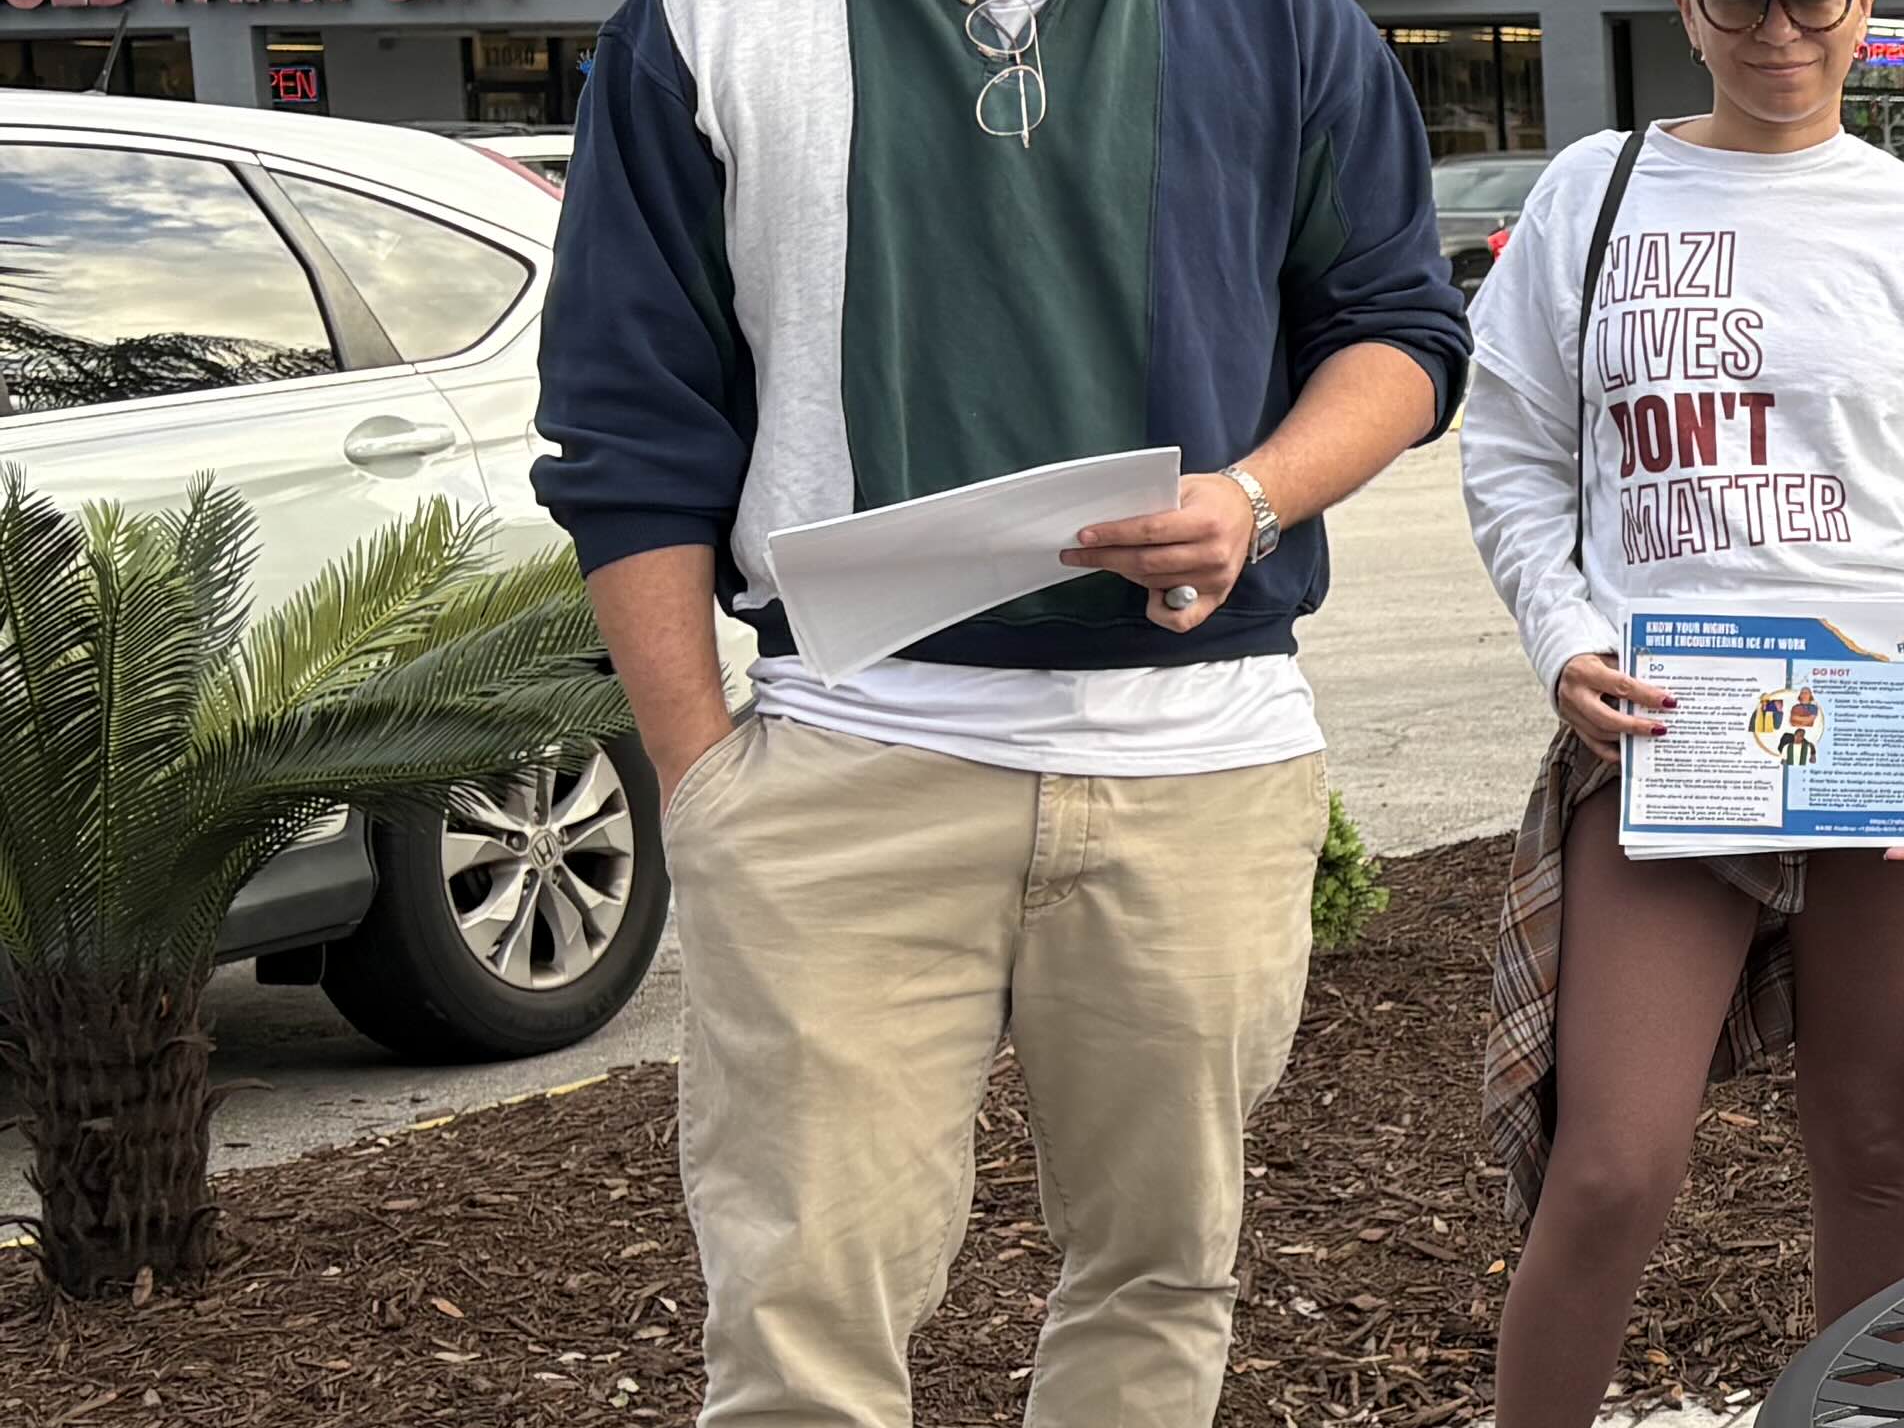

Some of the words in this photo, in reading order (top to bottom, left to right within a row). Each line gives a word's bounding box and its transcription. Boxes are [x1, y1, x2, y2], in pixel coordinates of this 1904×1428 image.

[1599, 230, 1737, 308] NAZI
[1597, 307, 1764, 393] LIVES
[1608, 392, 1776, 480] DON'T
[1619, 473, 1853, 566] MATTER
[1646, 621, 1673, 634] KNOW
[1676, 622, 1701, 634] YOUR
[1646, 635, 1672, 647] WHEN
[1674, 635, 1744, 649] ENCOUNTERING
[1745, 637, 1761, 649] ICE
[1763, 638, 1776, 650] AT
[1778, 638, 1807, 651] WORK
